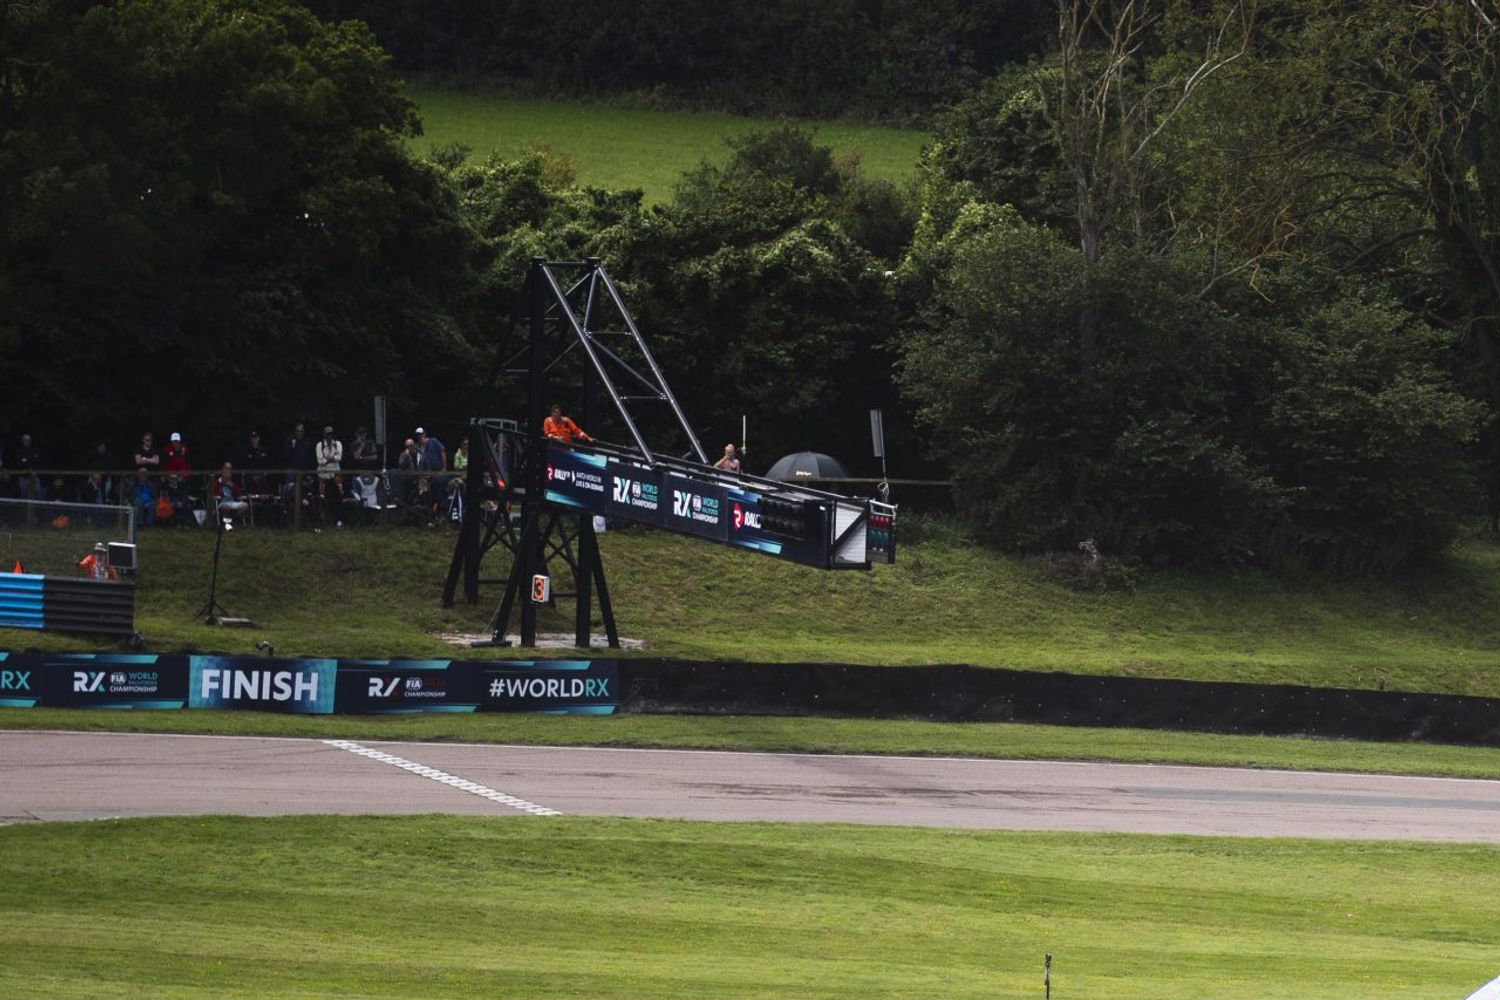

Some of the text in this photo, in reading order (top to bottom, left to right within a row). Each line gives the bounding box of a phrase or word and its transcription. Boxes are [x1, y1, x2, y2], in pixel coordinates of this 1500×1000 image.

[613, 476, 631, 504] RX
[642, 483, 658, 494] WORLD
[631, 498, 658, 511] CHAMPIONSHIP
[673, 490, 691, 519] RX
[702, 497, 719, 509] WORLD
[692, 511, 719, 524] CHAMPIONSHIP
[534, 577, 545, 599] 3
[73, 671, 106, 692] RX
[110, 672, 158, 684] FIA WORLD
[201, 668, 319, 701] FINISH
[406, 679, 422, 688] FIA
[109, 685, 158, 693] CHAMPIONSHIP
[489, 678, 610, 698] #WORLDRX
